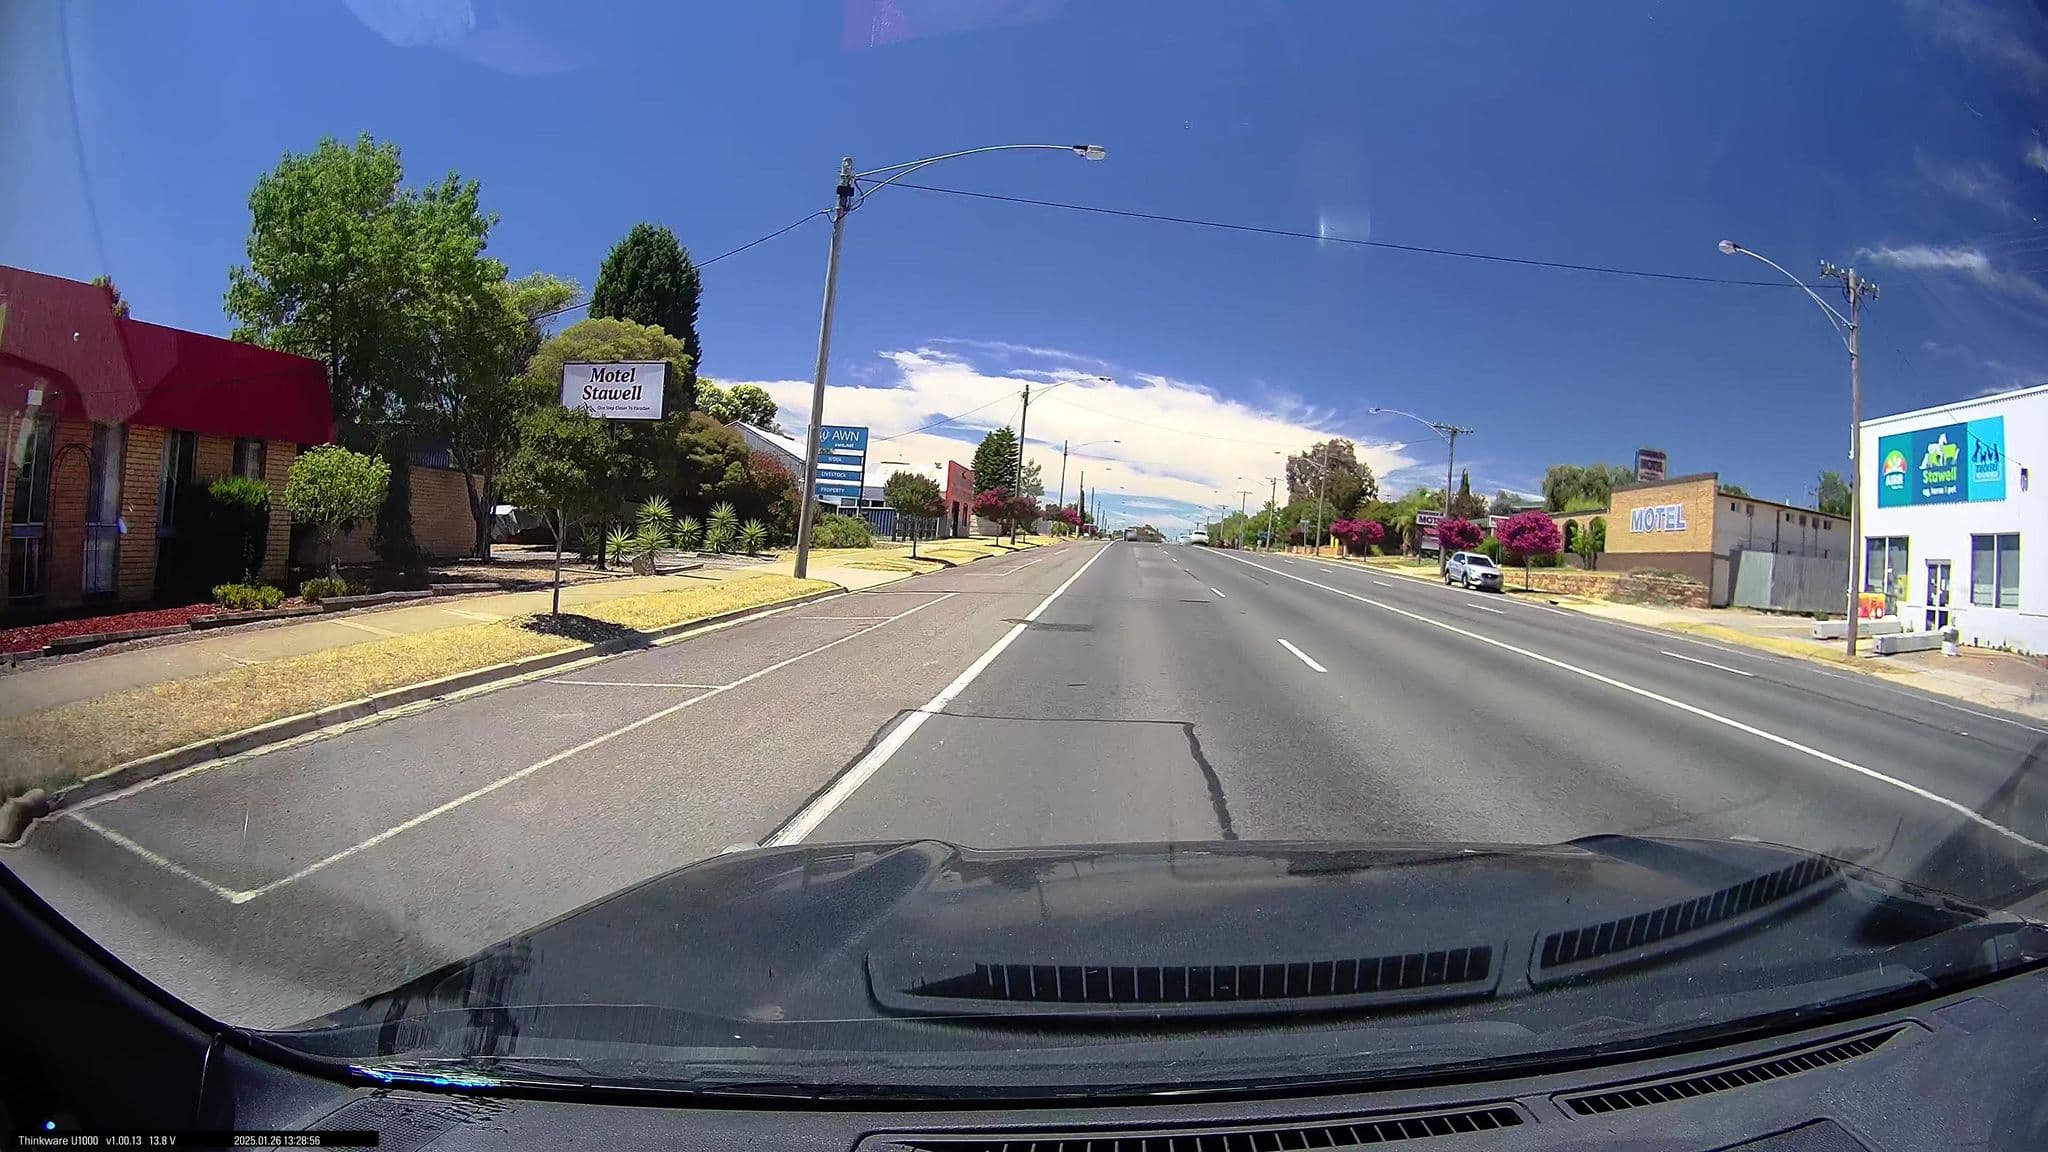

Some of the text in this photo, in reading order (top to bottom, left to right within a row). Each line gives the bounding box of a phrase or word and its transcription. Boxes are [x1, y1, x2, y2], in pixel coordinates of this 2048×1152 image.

[589, 367, 636, 383] Motel
[582, 385, 643, 401] Stawell
[831, 430, 859, 441] AWN
[1922, 467, 1957, 484] Stawell
[1630, 504, 1686, 532] MOTEL
